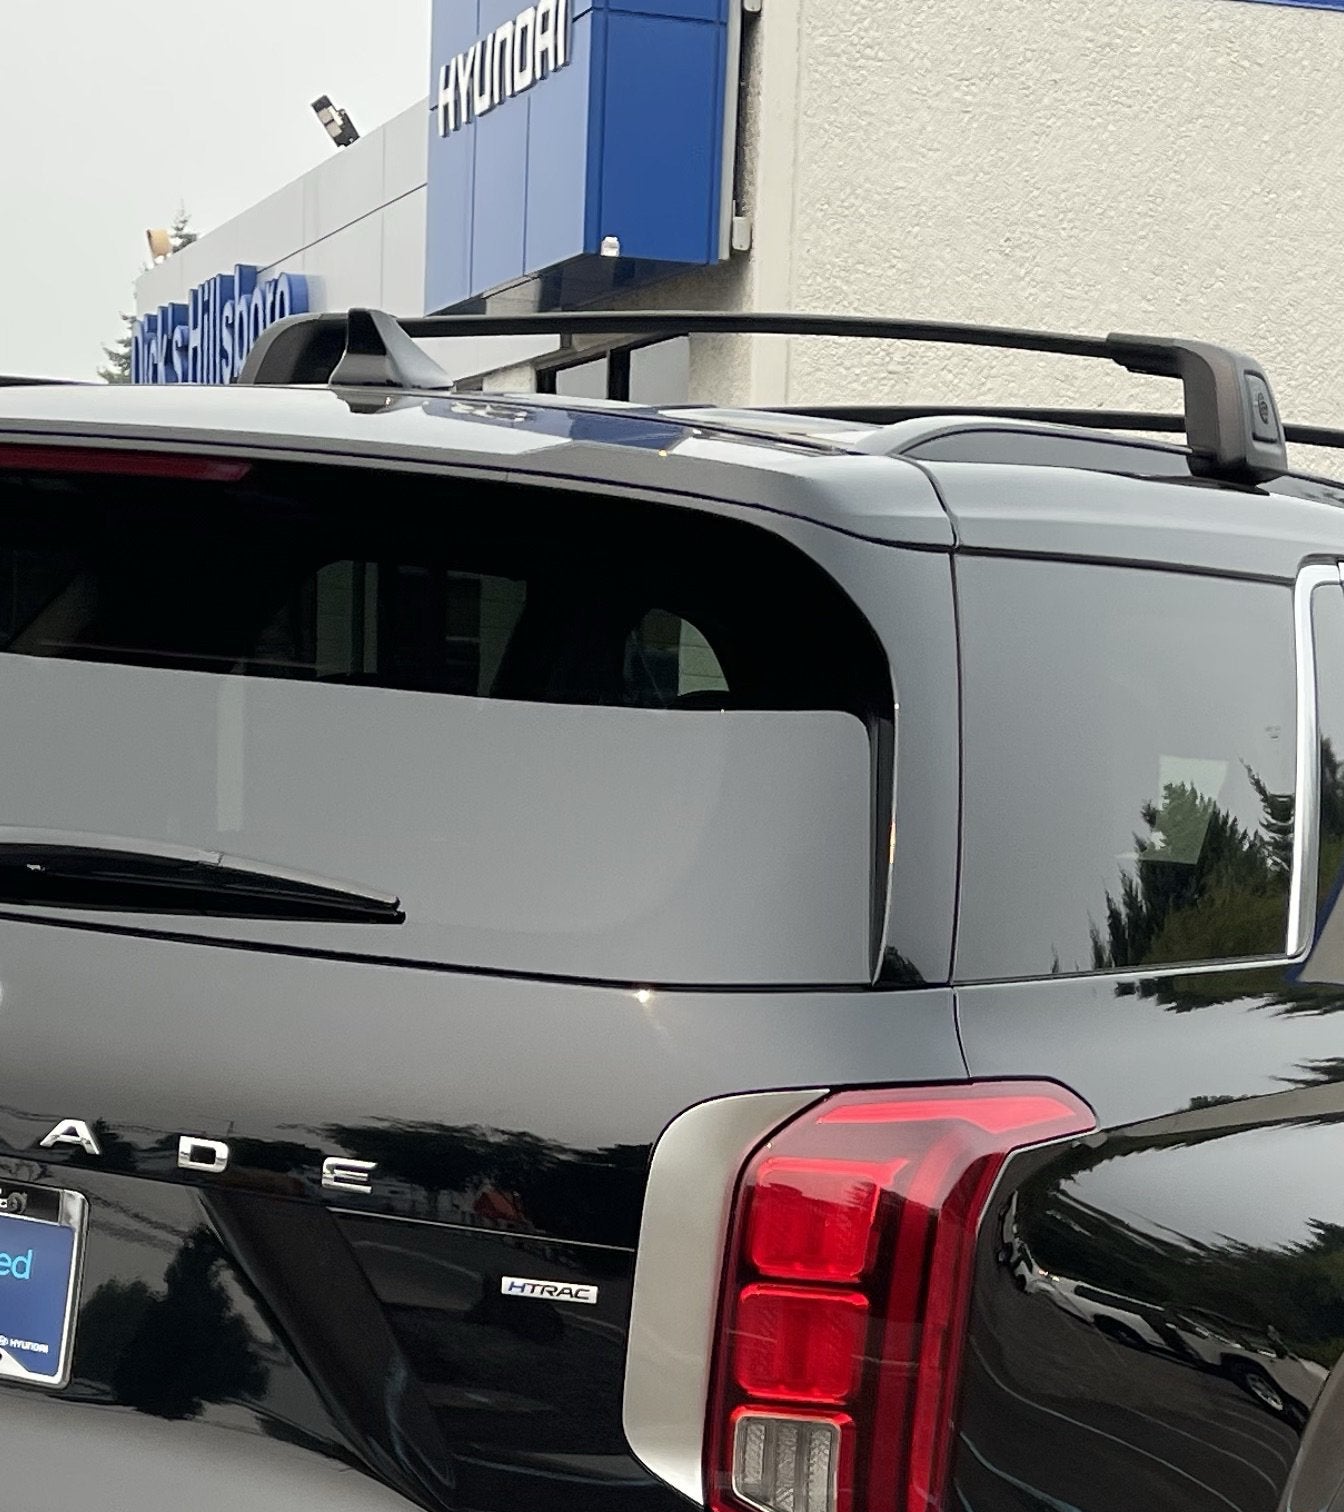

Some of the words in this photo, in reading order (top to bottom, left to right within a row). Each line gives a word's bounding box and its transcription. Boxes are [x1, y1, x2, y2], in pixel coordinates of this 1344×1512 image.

[438, 0, 568, 137] HYUNDAI
[508, 1281, 591, 1300] HTRAC
[9, 1338, 49, 1354] HYUNDAI
